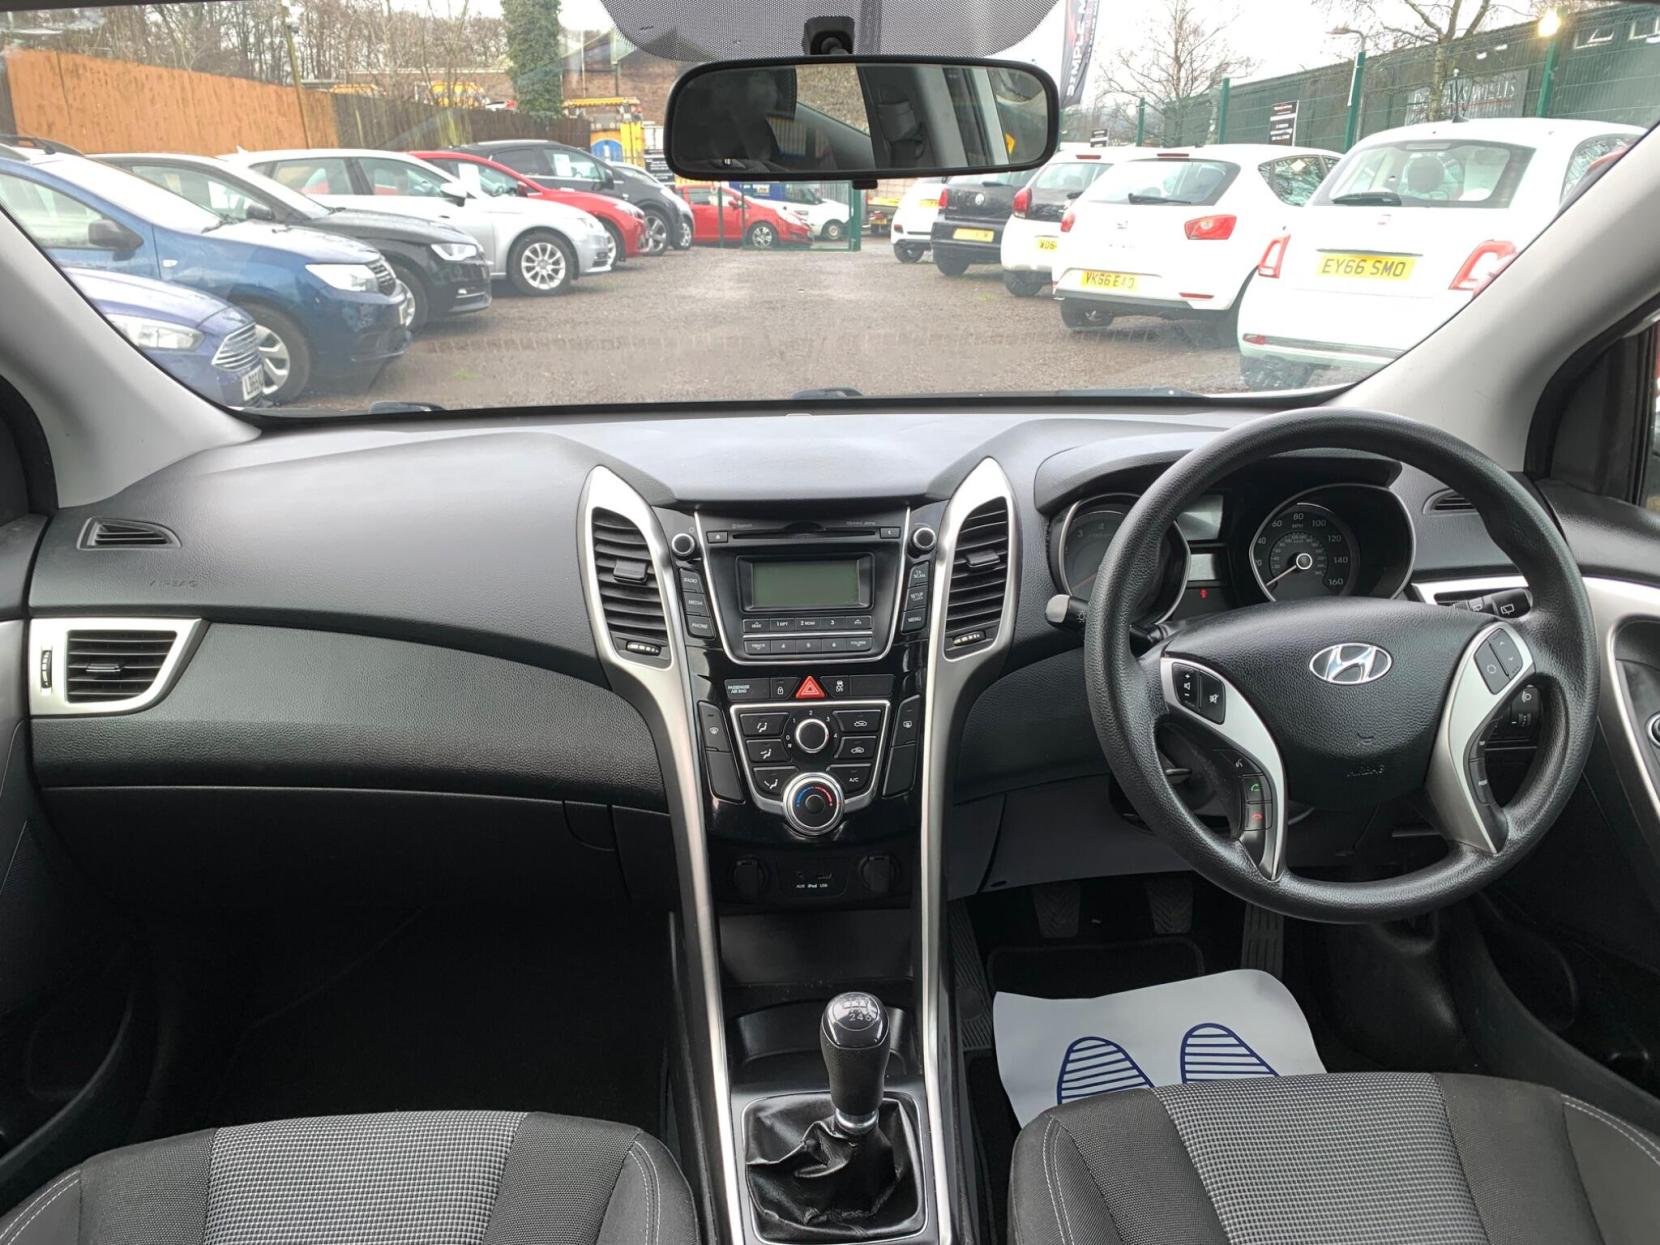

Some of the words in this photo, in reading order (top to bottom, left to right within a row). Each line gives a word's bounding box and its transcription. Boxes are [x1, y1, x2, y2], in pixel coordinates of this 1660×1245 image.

[1321, 258, 1366, 275] EY66
[1369, 260, 1407, 277] SMO
[1328, 535, 1341, 543] 120
[1333, 556, 1349, 564] 140
[1328, 578, 1344, 586] 160
[849, 1013, 856, 1022] 2
[857, 1013, 864, 1021] 4
